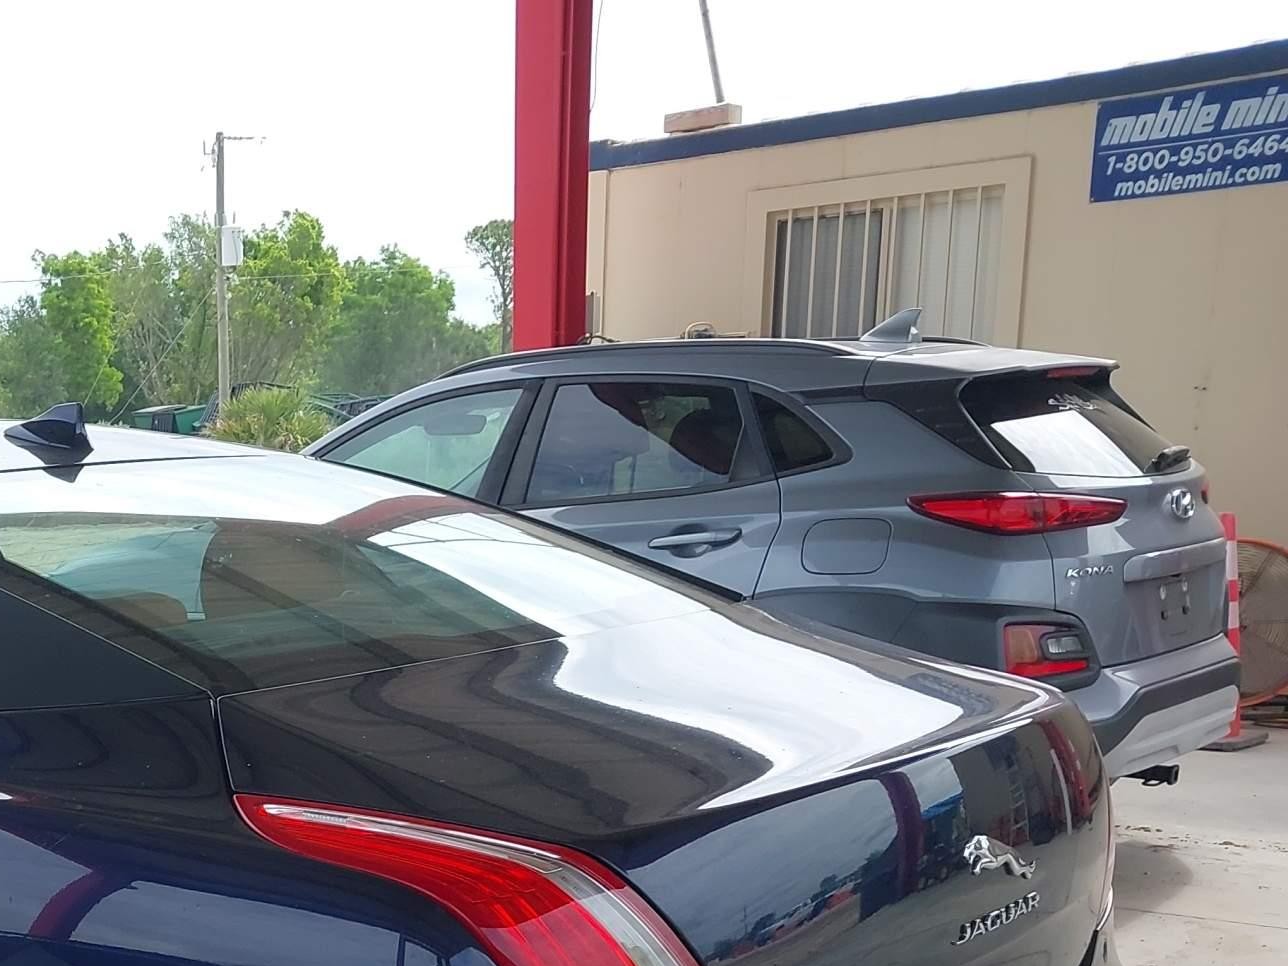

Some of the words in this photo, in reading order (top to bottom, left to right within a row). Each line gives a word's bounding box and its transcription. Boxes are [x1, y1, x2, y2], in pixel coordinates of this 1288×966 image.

[1100, 91, 1221, 146] mobile
[1113, 162, 1282, 197] mobilemini.com
[1066, 565, 1113, 577] KONA
[954, 891, 1041, 945] JAGUAR
